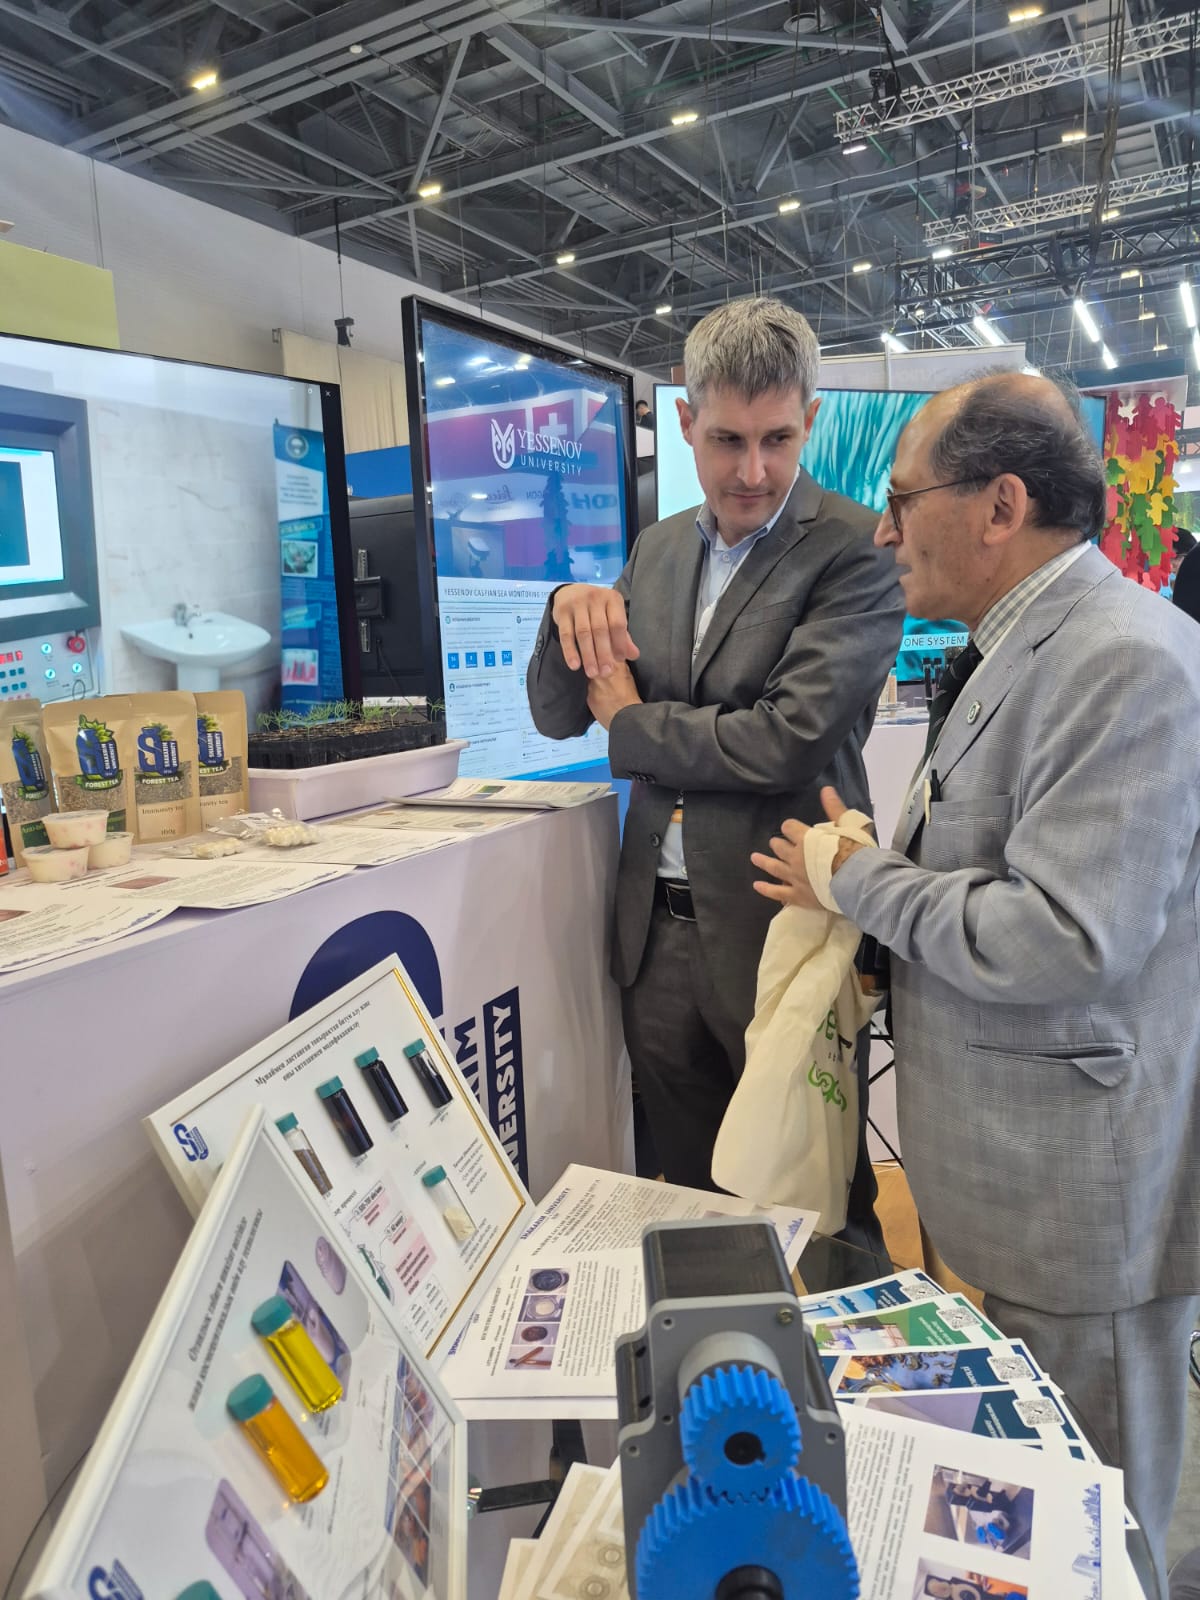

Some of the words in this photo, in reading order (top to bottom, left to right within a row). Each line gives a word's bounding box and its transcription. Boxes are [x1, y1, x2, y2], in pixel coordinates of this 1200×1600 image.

[517, 427, 582, 461] YESSENOV
[520, 454, 582, 476] UNIVERSITY
[927, 635, 965, 648] SYSTEM
[84, 779, 108, 788] FOREST
[108, 778, 119, 787] TEA
[141, 777, 167, 786] FOREST
[167, 776, 180, 784] TEA
[493, 1005, 519, 1166] VERSITY
